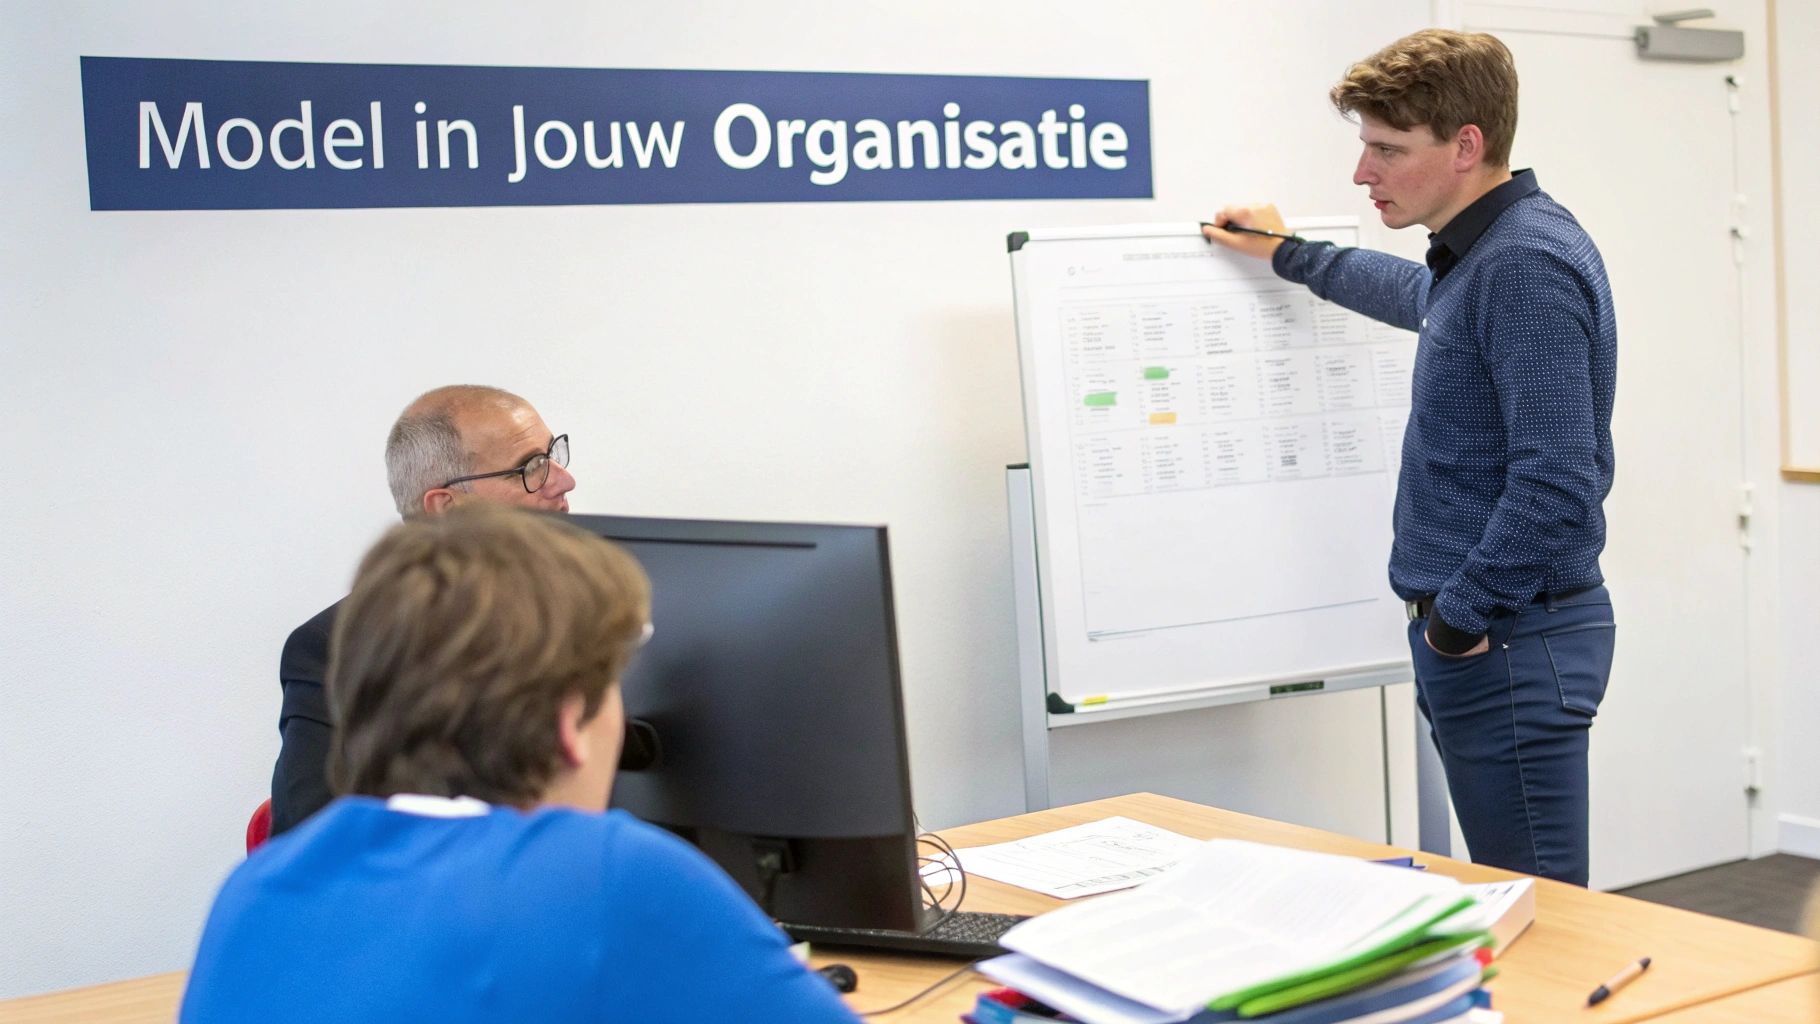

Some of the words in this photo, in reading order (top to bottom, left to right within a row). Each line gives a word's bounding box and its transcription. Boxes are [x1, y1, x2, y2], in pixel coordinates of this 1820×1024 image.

[139, 101, 384, 170] Model
[414, 102, 478, 169] in
[508, 105, 686, 183] Jouw
[713, 102, 1129, 186] Organisatie
